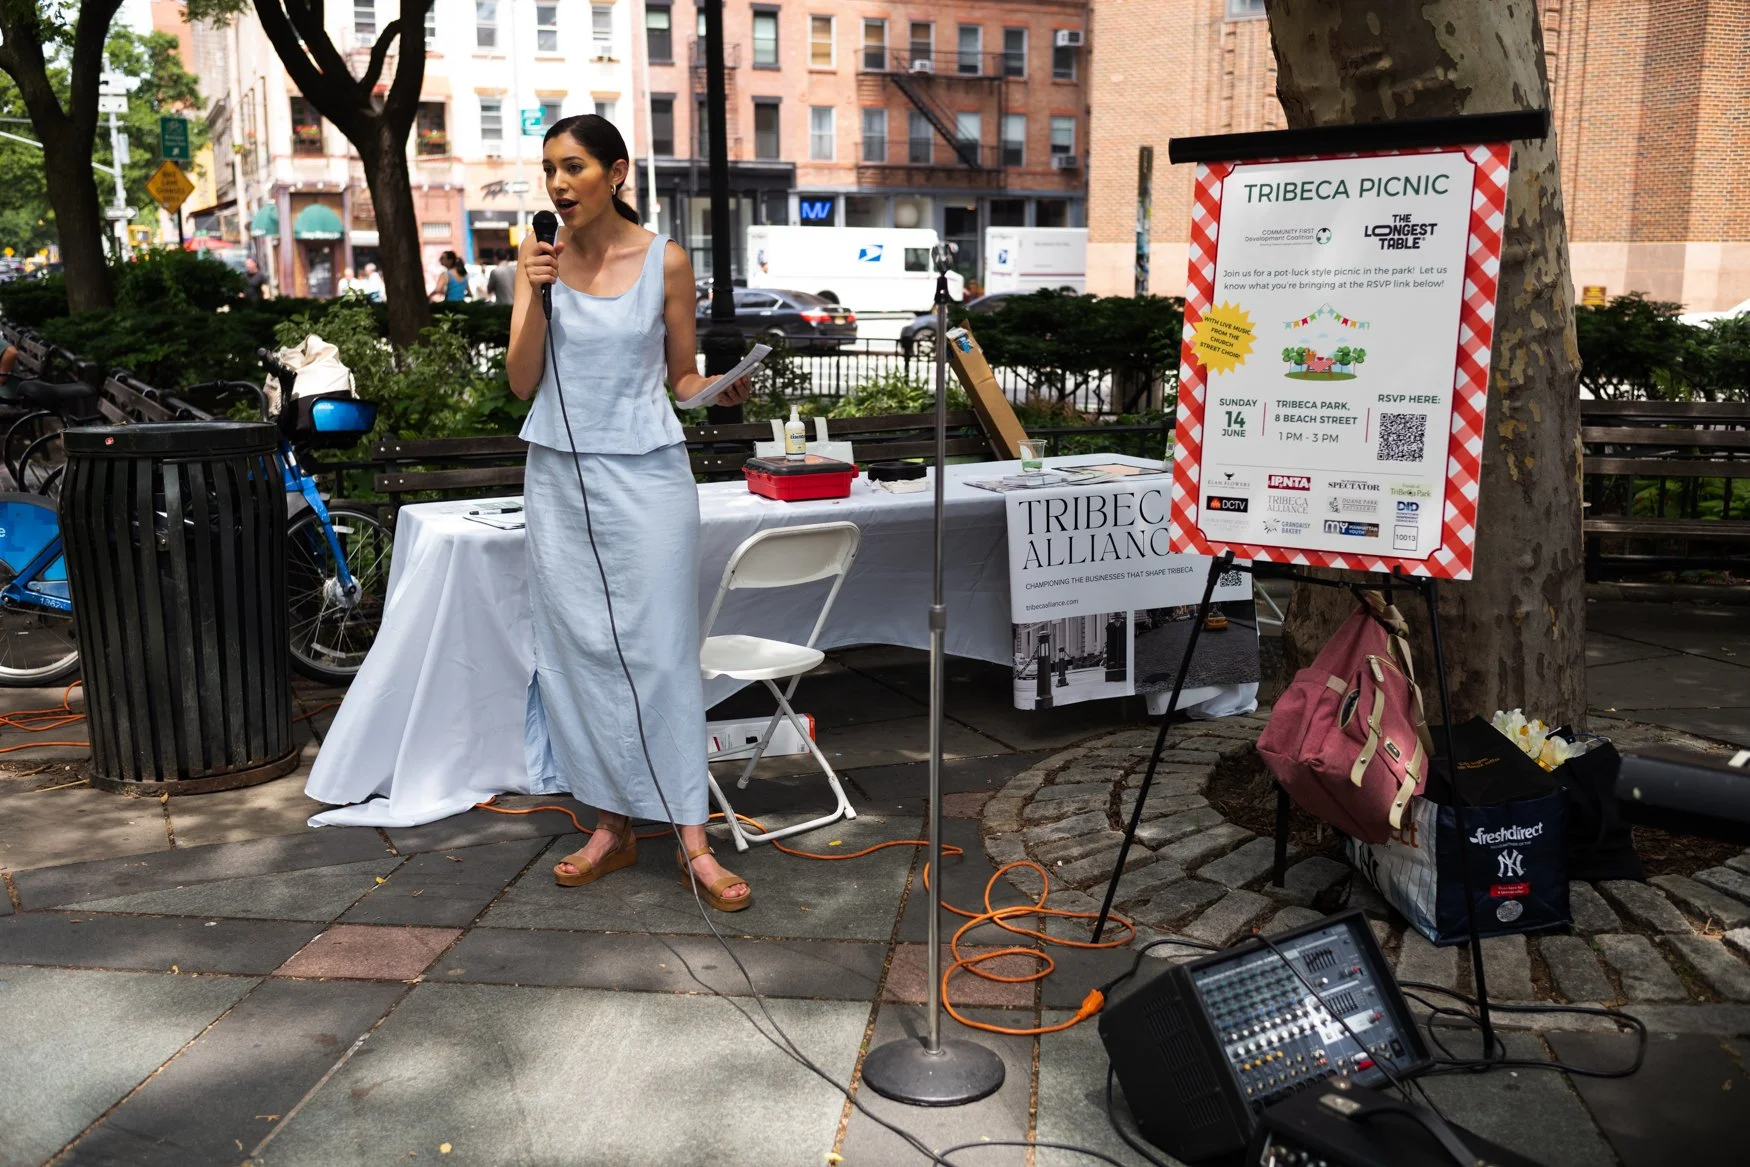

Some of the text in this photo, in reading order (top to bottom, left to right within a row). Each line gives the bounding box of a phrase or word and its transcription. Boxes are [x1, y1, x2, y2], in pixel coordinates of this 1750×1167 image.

[1243, 174, 1450, 204] TRIBECA PICNIC
[1392, 214, 1412, 223] THE
[1262, 228, 1298, 236] COMMUNITY
[1364, 223, 1438, 238] LONGEST
[1223, 269, 1240, 278] Join
[1253, 268, 1265, 277] for
[1273, 267, 1309, 279] pot-luck
[1311, 267, 1332, 278] style
[1333, 266, 1361, 278] picnic
[1363, 266, 1372, 275] in
[1373, 266, 1389, 275] the
[1390, 266, 1415, 277] park!
[1419, 265, 1434, 274] Let
[1224, 279, 1444, 292] know what you're bringing at the RSVP link below!
[1204, 316, 1251, 336] WITH LIVE MUSIC
[1211, 327, 1240, 341] FROM THE
[1200, 342, 1220, 353] STREET
[1210, 336, 1234, 348] CHURCH
[1219, 398, 1258, 408] SUNDAY
[1378, 394, 1441, 404] RSVP HERE:
[1276, 400, 1350, 412] TRIBECA PARK,
[1225, 411, 1246, 429] 14
[1275, 414, 1358, 425] 8 BEACH STREET
[1221, 428, 1246, 438] JUNE
[1287, 432, 1303, 442] PM
[1312, 433, 1319, 442] 3
[1322, 433, 1339, 443] PM
[1328, 482, 1380, 491] SPECTATOR
[1222, 499, 1246, 510] DCTV
[1267, 496, 1309, 507] TRIBECA
[1397, 501, 1419, 511] DID
[1267, 505, 1309, 514] ALLIANCE
[1022, 528, 1183, 570] ALLIANC
[1025, 566, 1194, 590] CHAMPIONING THE BUSINESSES THAT SHAPE TRIBECA
[1025, 598, 1079, 611] tribecaalliance.com
[1474, 821, 1544, 845] freshdirect
[1497, 849, 1525, 878] NY
